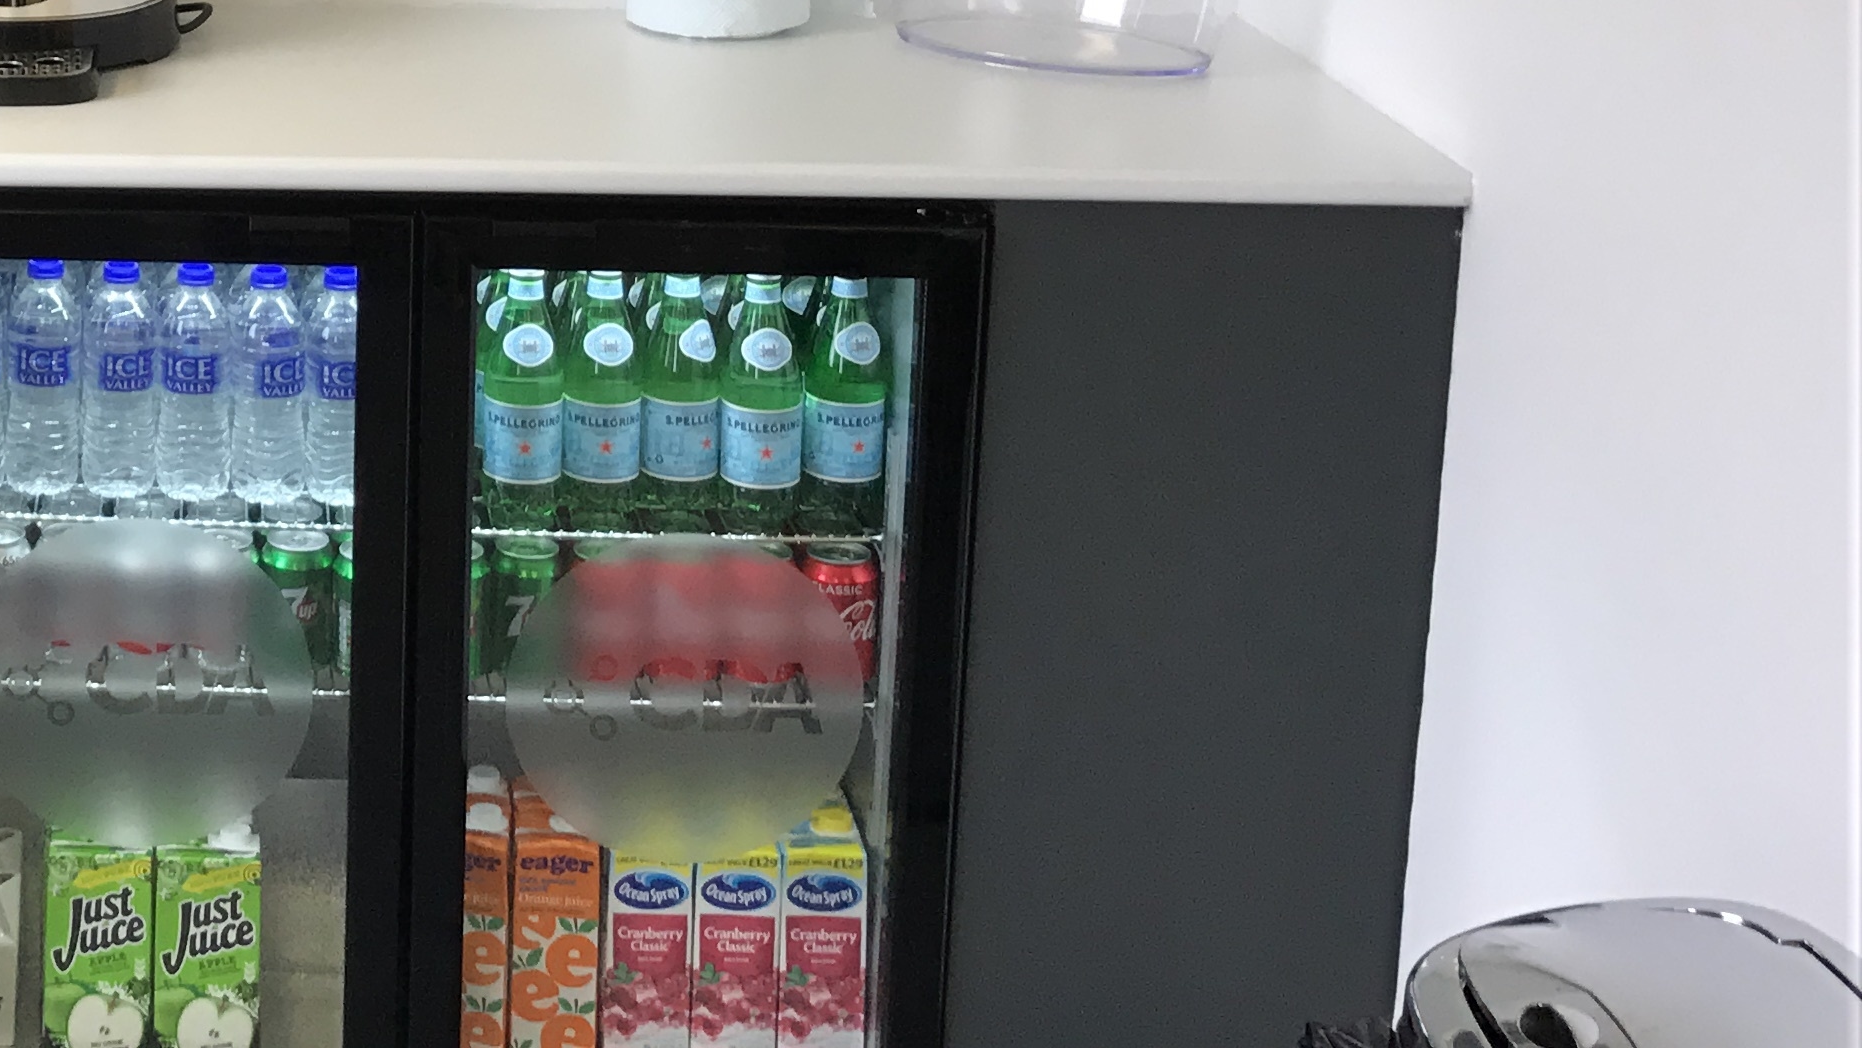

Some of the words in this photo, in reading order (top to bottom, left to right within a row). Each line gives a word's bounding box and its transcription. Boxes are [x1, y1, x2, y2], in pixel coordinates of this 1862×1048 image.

[21, 349, 66, 372] ICE
[167, 358, 212, 380] ICE
[812, 580, 864, 595] LASSIC
[520, 854, 594, 875] eager
[618, 882, 650, 902] Ocean
[650, 886, 680, 905] Spray
[706, 883, 737, 904] Ocean
[738, 886, 768, 907] Spray
[791, 884, 823, 904] Ocean
[823, 887, 854, 908] Spray
[617, 925, 684, 941] Cranberry
[704, 926, 771, 944] Cranberry
[790, 927, 858, 945] Cranberry
[631, 939, 669, 952] Classic
[717, 940, 756, 953] Classic
[803, 941, 844, 954] Classic
